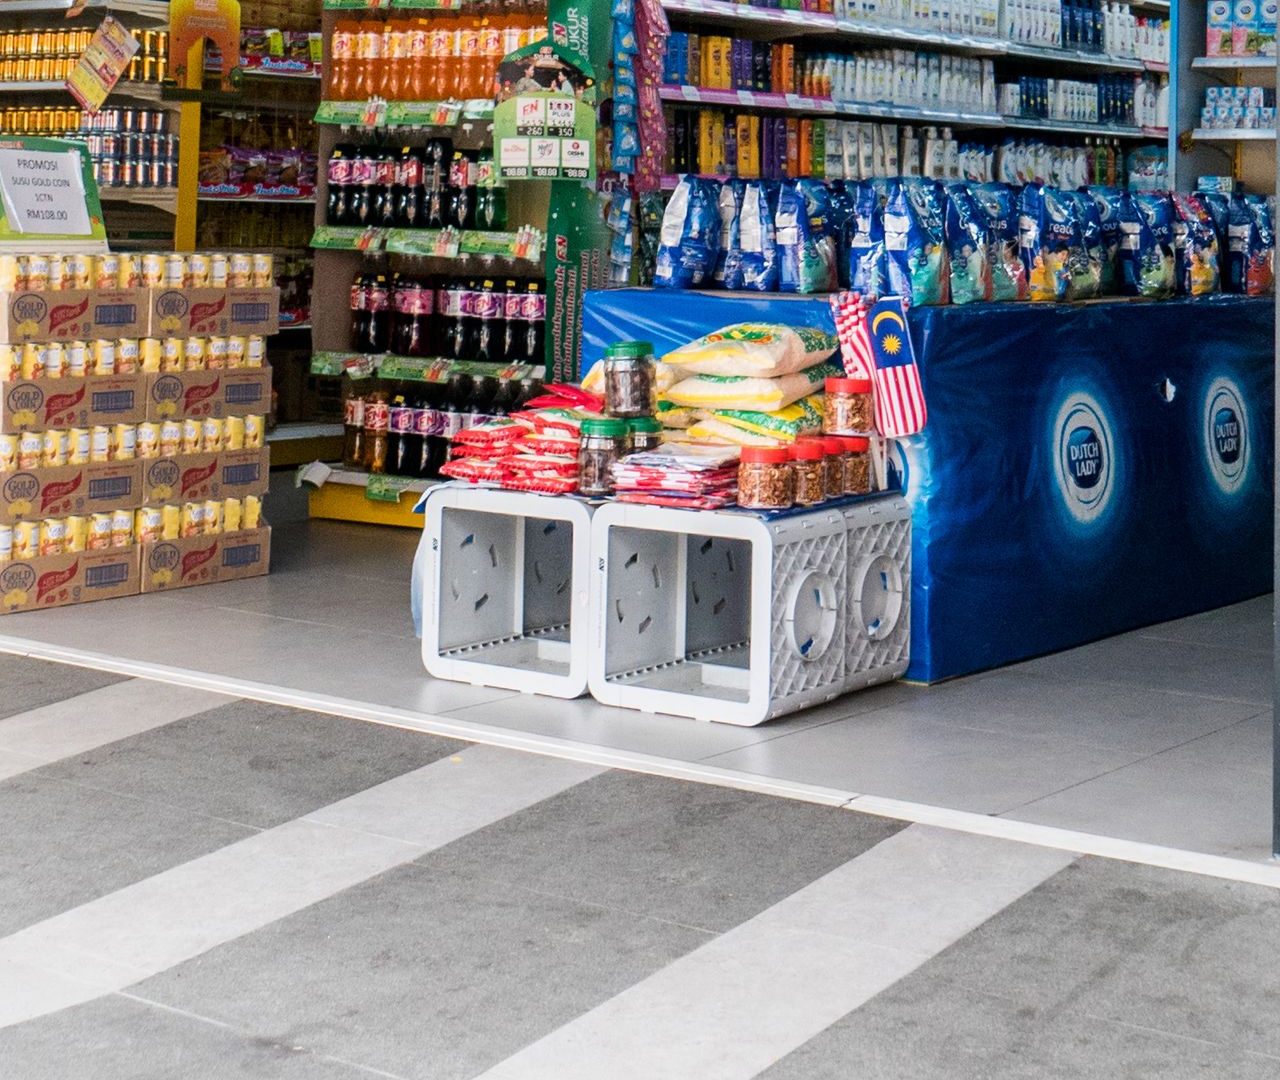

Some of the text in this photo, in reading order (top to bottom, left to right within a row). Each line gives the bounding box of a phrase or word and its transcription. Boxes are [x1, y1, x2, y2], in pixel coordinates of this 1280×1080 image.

[17, 158, 58, 171] PROMOSI
[11, 176, 70, 187] SUSU GOLD COIN
[26, 209, 68, 221] RM108.00
[11, 390, 40, 402] GOLD
[1215, 422, 1239, 439] DUTCH
[1070, 441, 1100, 461] DUTCH
[1219, 438, 1240, 453] LADY
[1075, 459, 1100, 477] LADY
[8, 478, 36, 491] GOLD
[1, 571, 32, 583] GOLD
